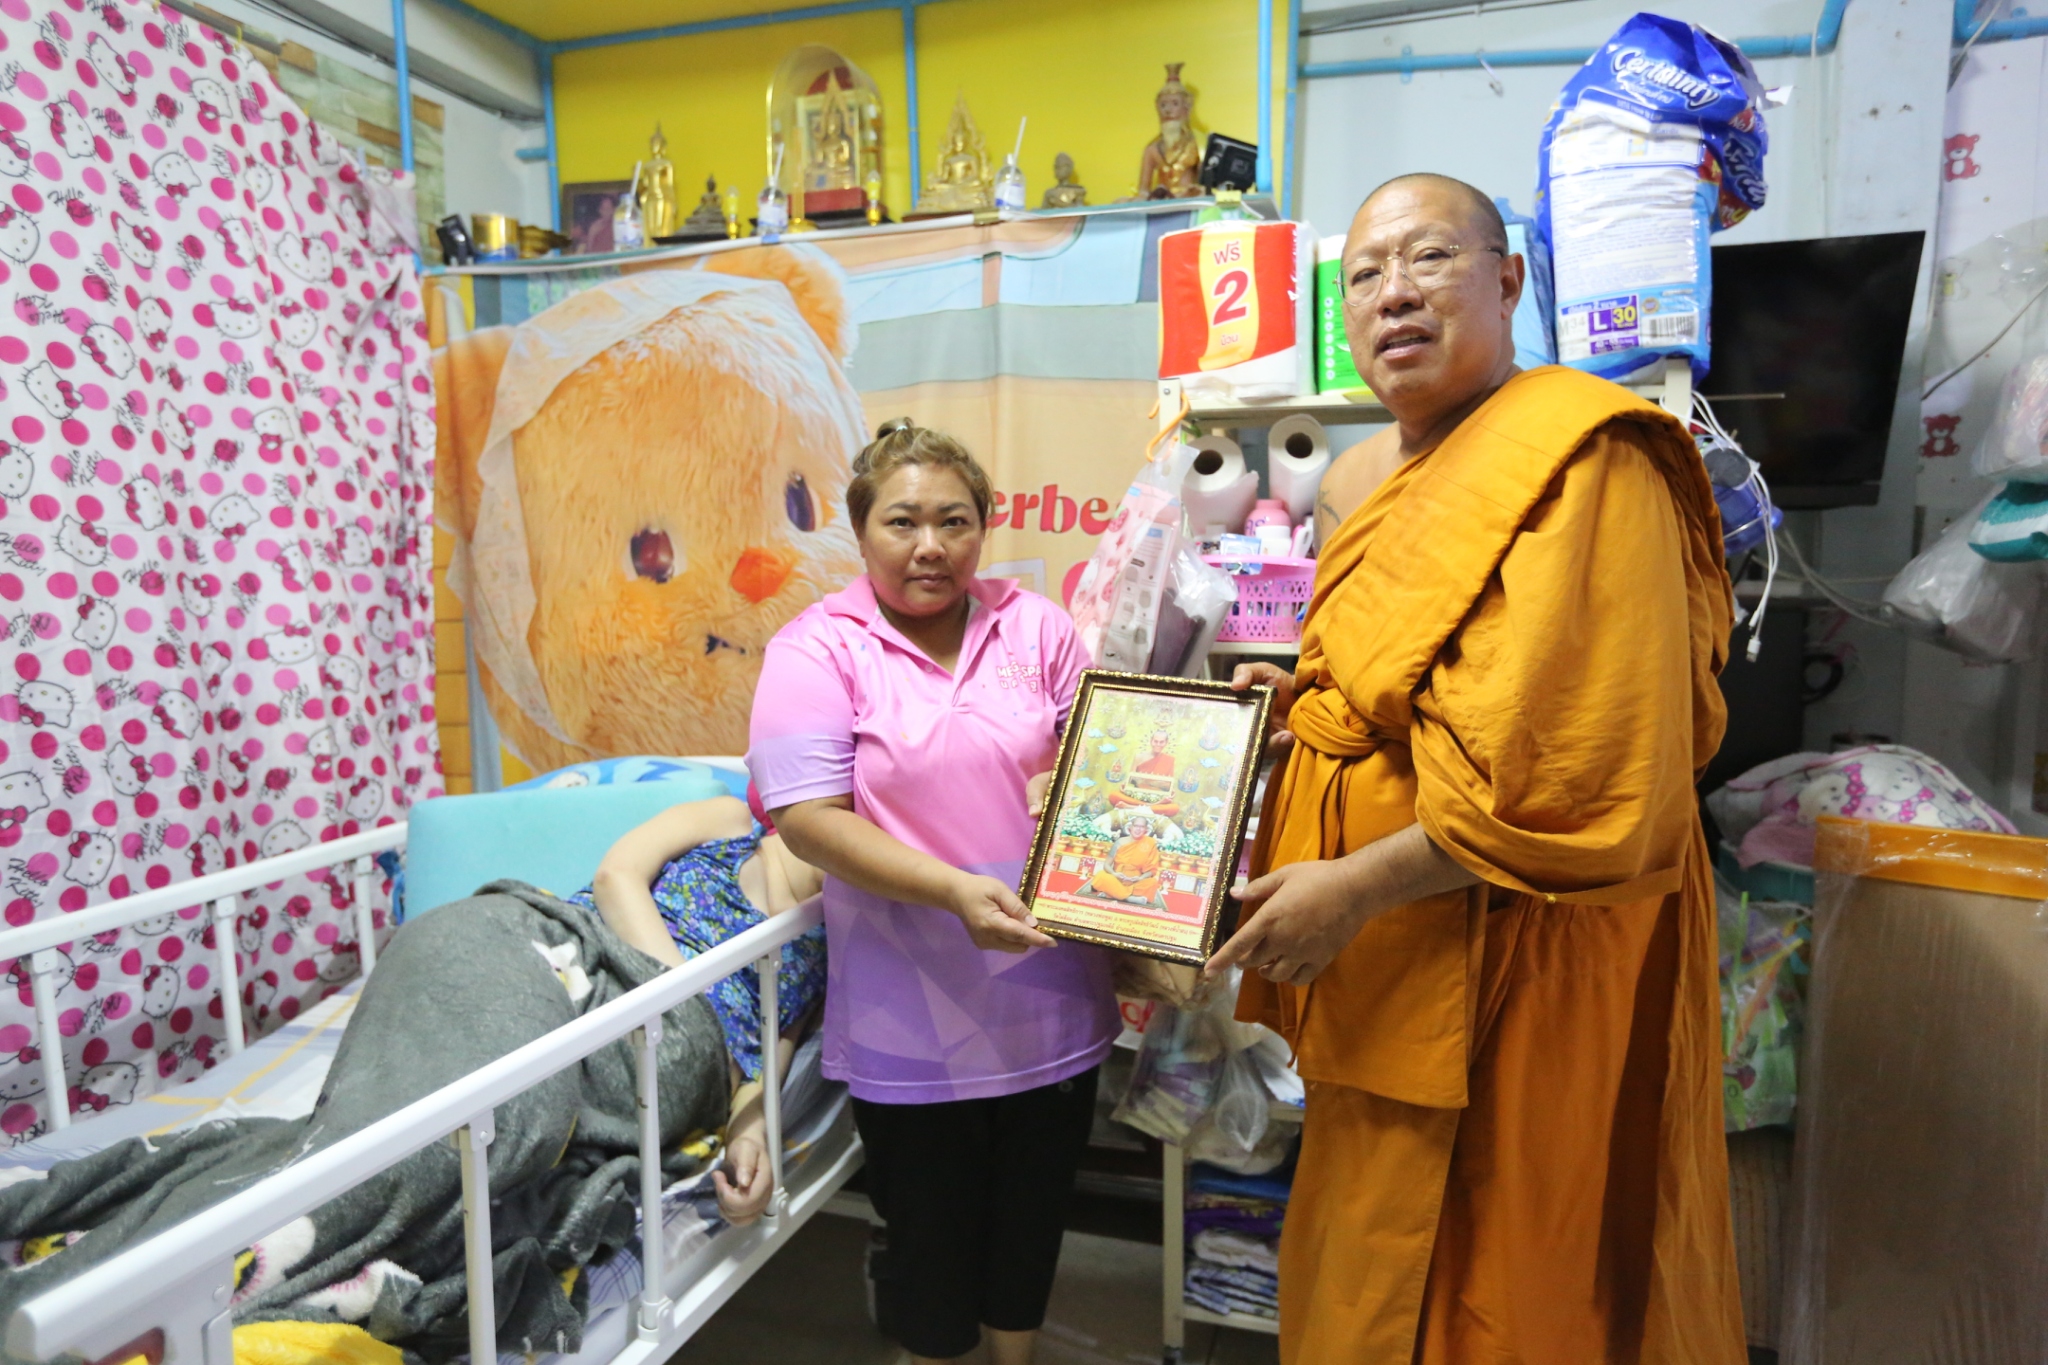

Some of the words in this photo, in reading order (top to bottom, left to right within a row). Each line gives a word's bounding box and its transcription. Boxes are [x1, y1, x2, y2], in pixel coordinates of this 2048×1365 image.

[1614, 49, 1720, 109] Certainty
[1213, 241, 1241, 265] ฟรี
[1213, 270, 1249, 327] 2
[1593, 312, 1608, 331] L
[1612, 306, 1636, 324] 30
[986, 484, 1119, 535] erbe
[0, 532, 40, 554] Hello
[3, 549, 47, 577] Kitty
[149, 817, 172, 858] Kitty
[8, 857, 49, 887] Hello
[6, 876, 44, 909] Kitty
[83, 938, 122, 958] Kitty
